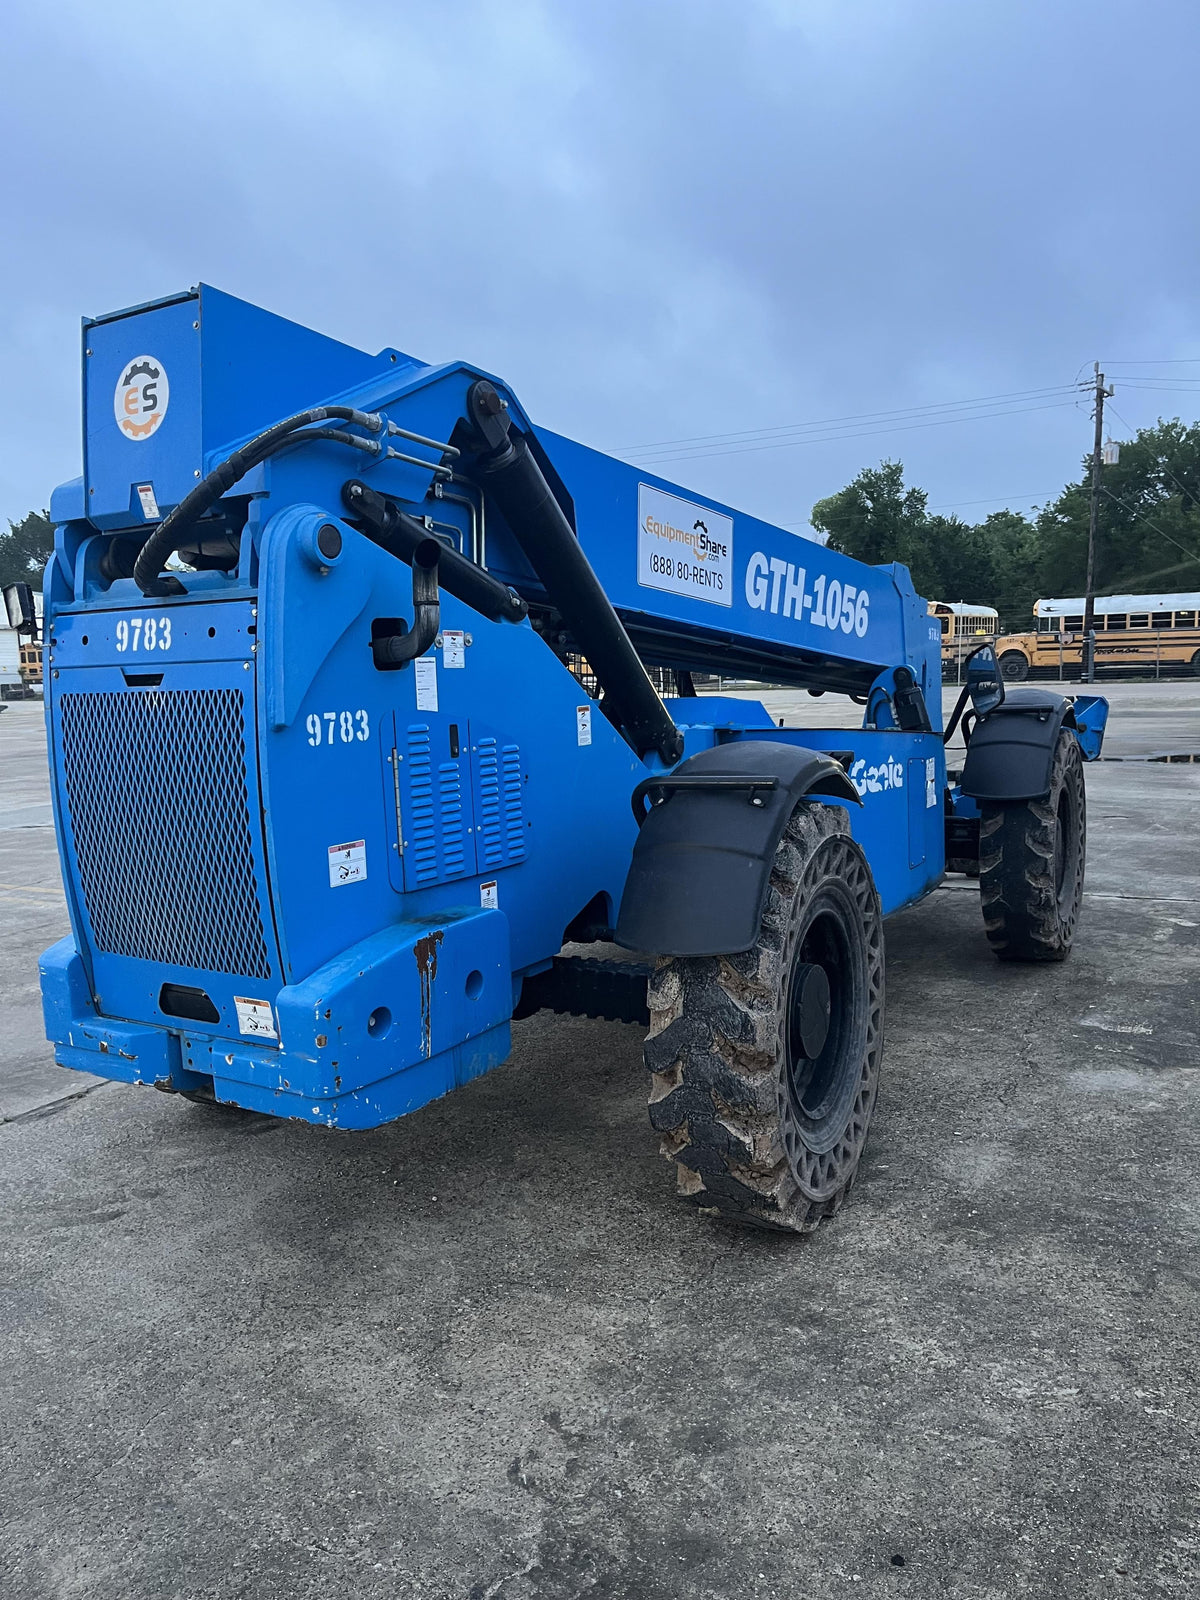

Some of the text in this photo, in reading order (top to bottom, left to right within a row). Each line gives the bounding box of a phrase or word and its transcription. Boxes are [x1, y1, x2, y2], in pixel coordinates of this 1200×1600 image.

[124, 382, 158, 415] ES
[645, 515, 727, 558] EquipmentShare
[649, 552, 724, 591] (888) 80-RENTS
[744, 551, 870, 638] GTH-1056
[115, 617, 172, 652] 9783
[306, 709, 370, 747] 9783
